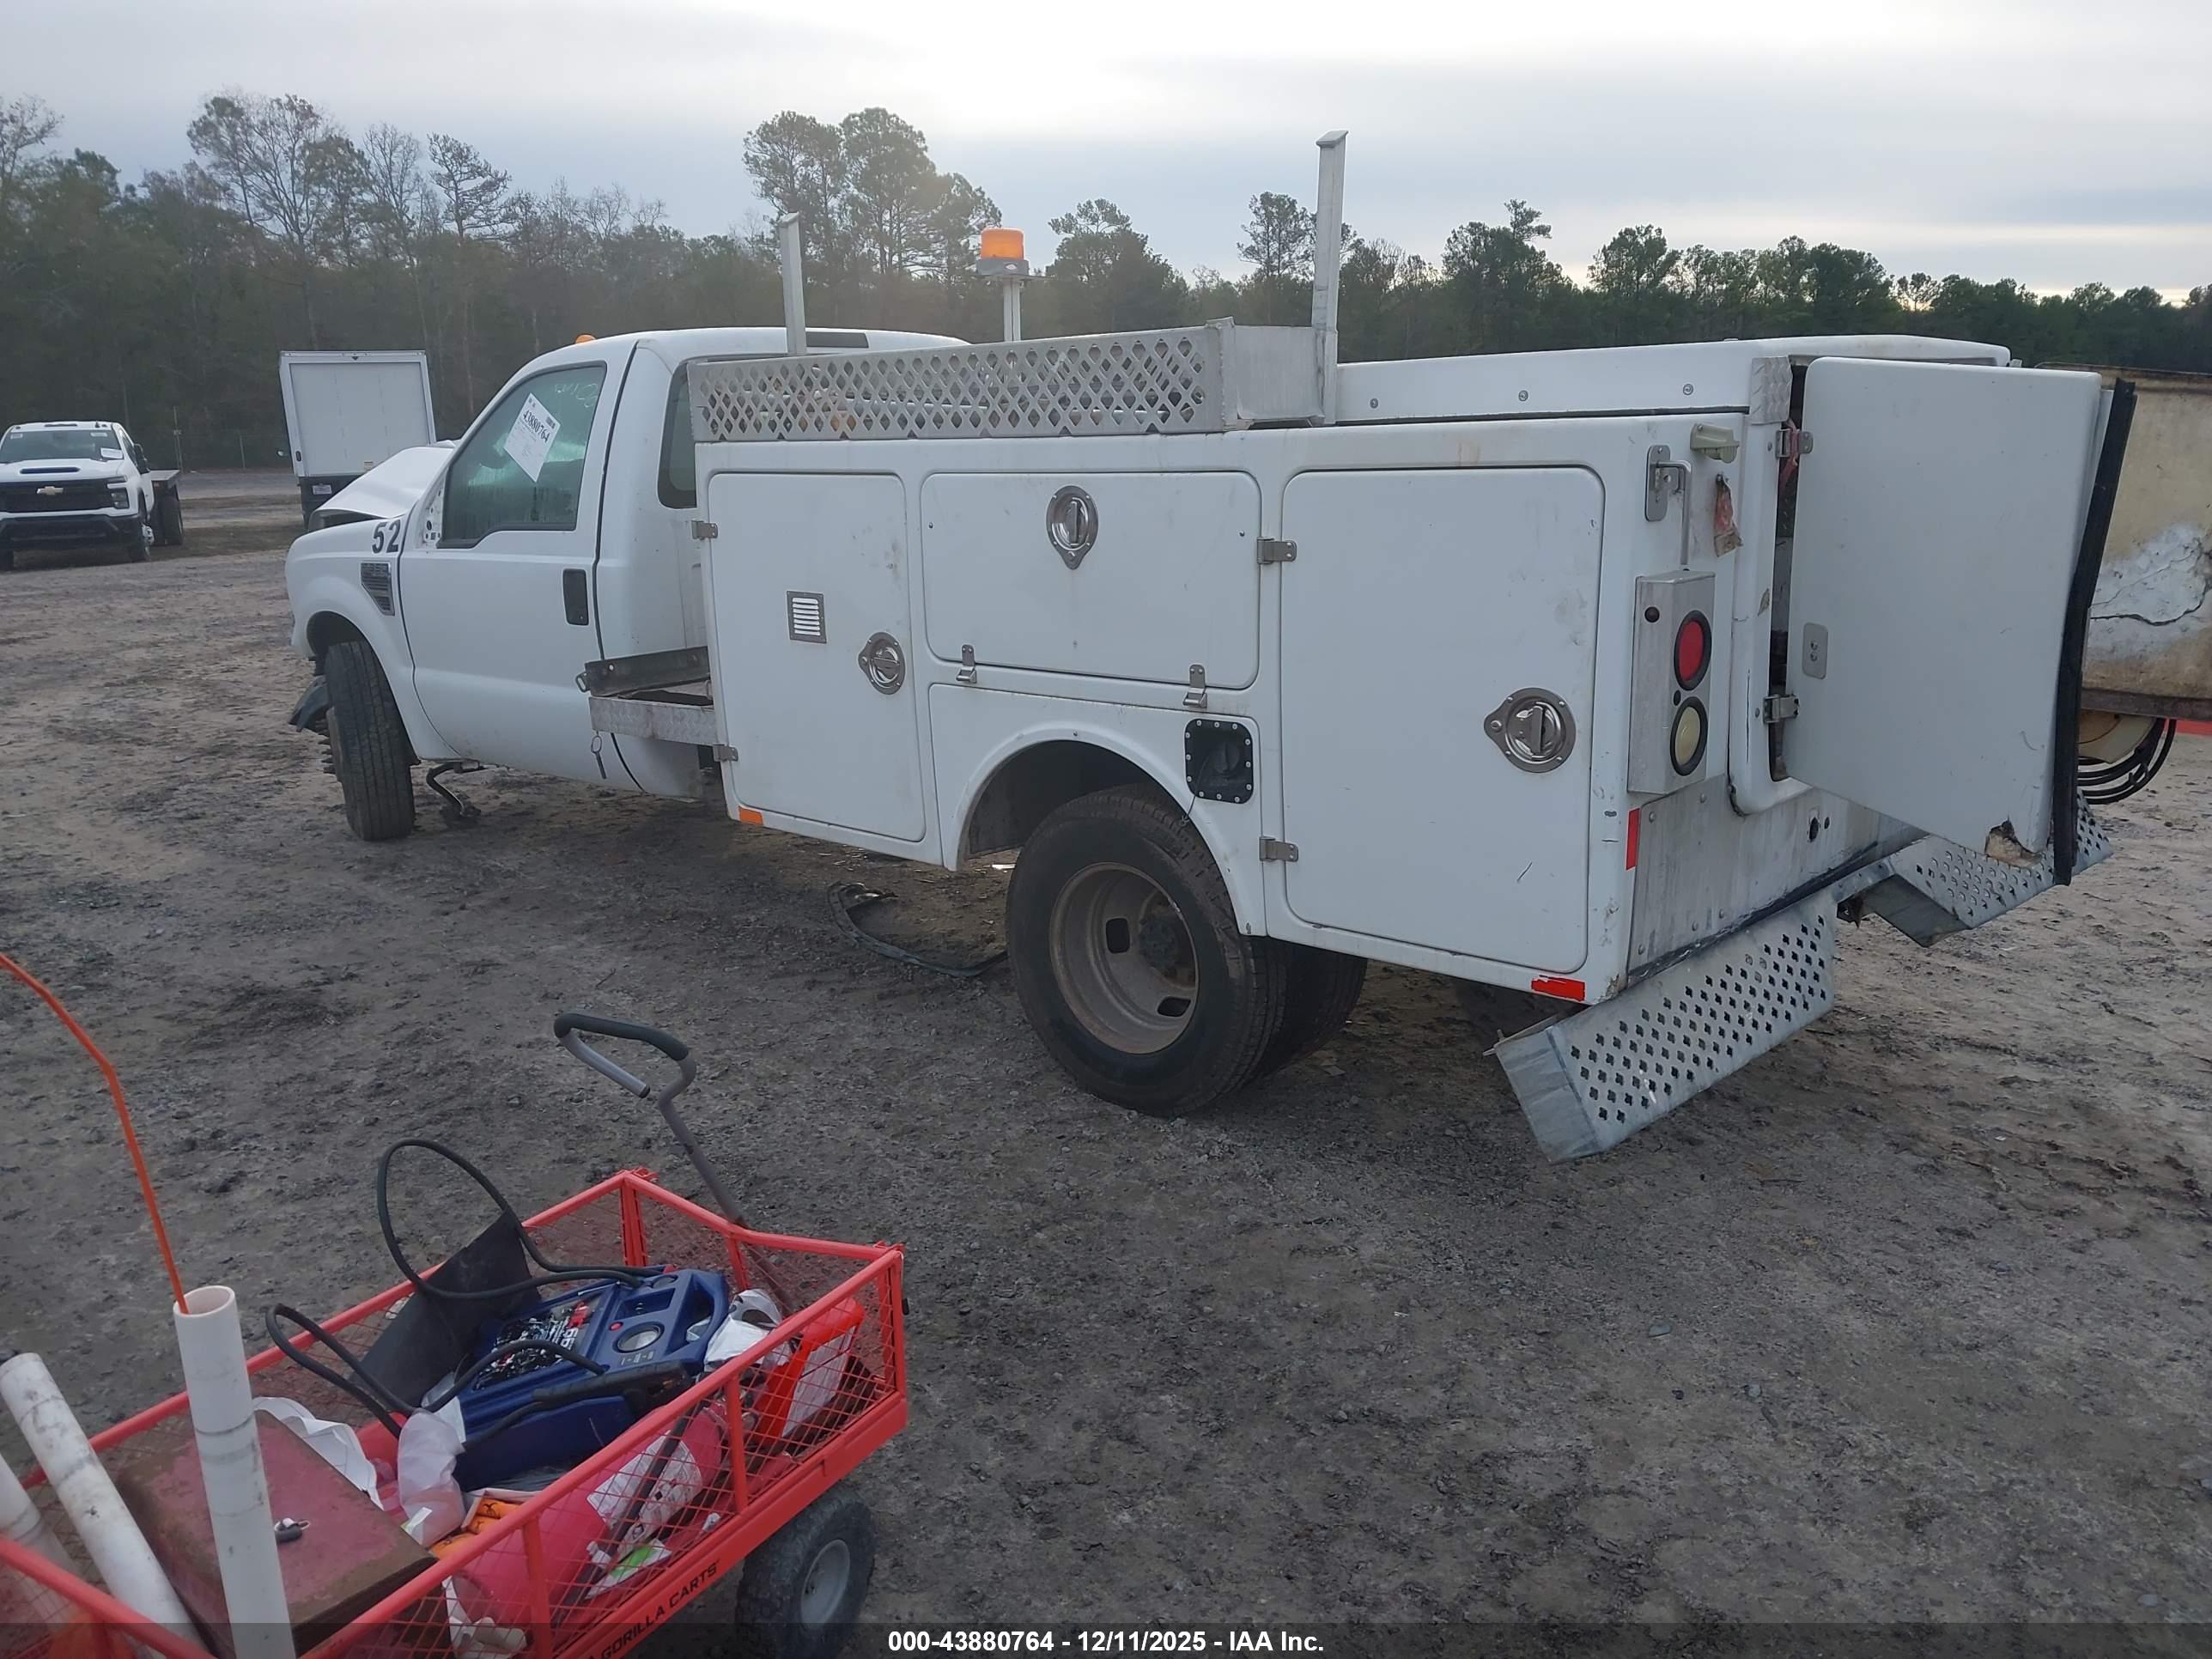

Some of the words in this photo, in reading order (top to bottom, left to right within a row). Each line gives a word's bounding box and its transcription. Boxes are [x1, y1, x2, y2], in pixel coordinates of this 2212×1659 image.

[522, 410, 550, 443] 43880764
[372, 519, 401, 554] 52
[601, 1605, 665, 1659] GORILLA
[669, 1563, 718, 1608] CARTS
